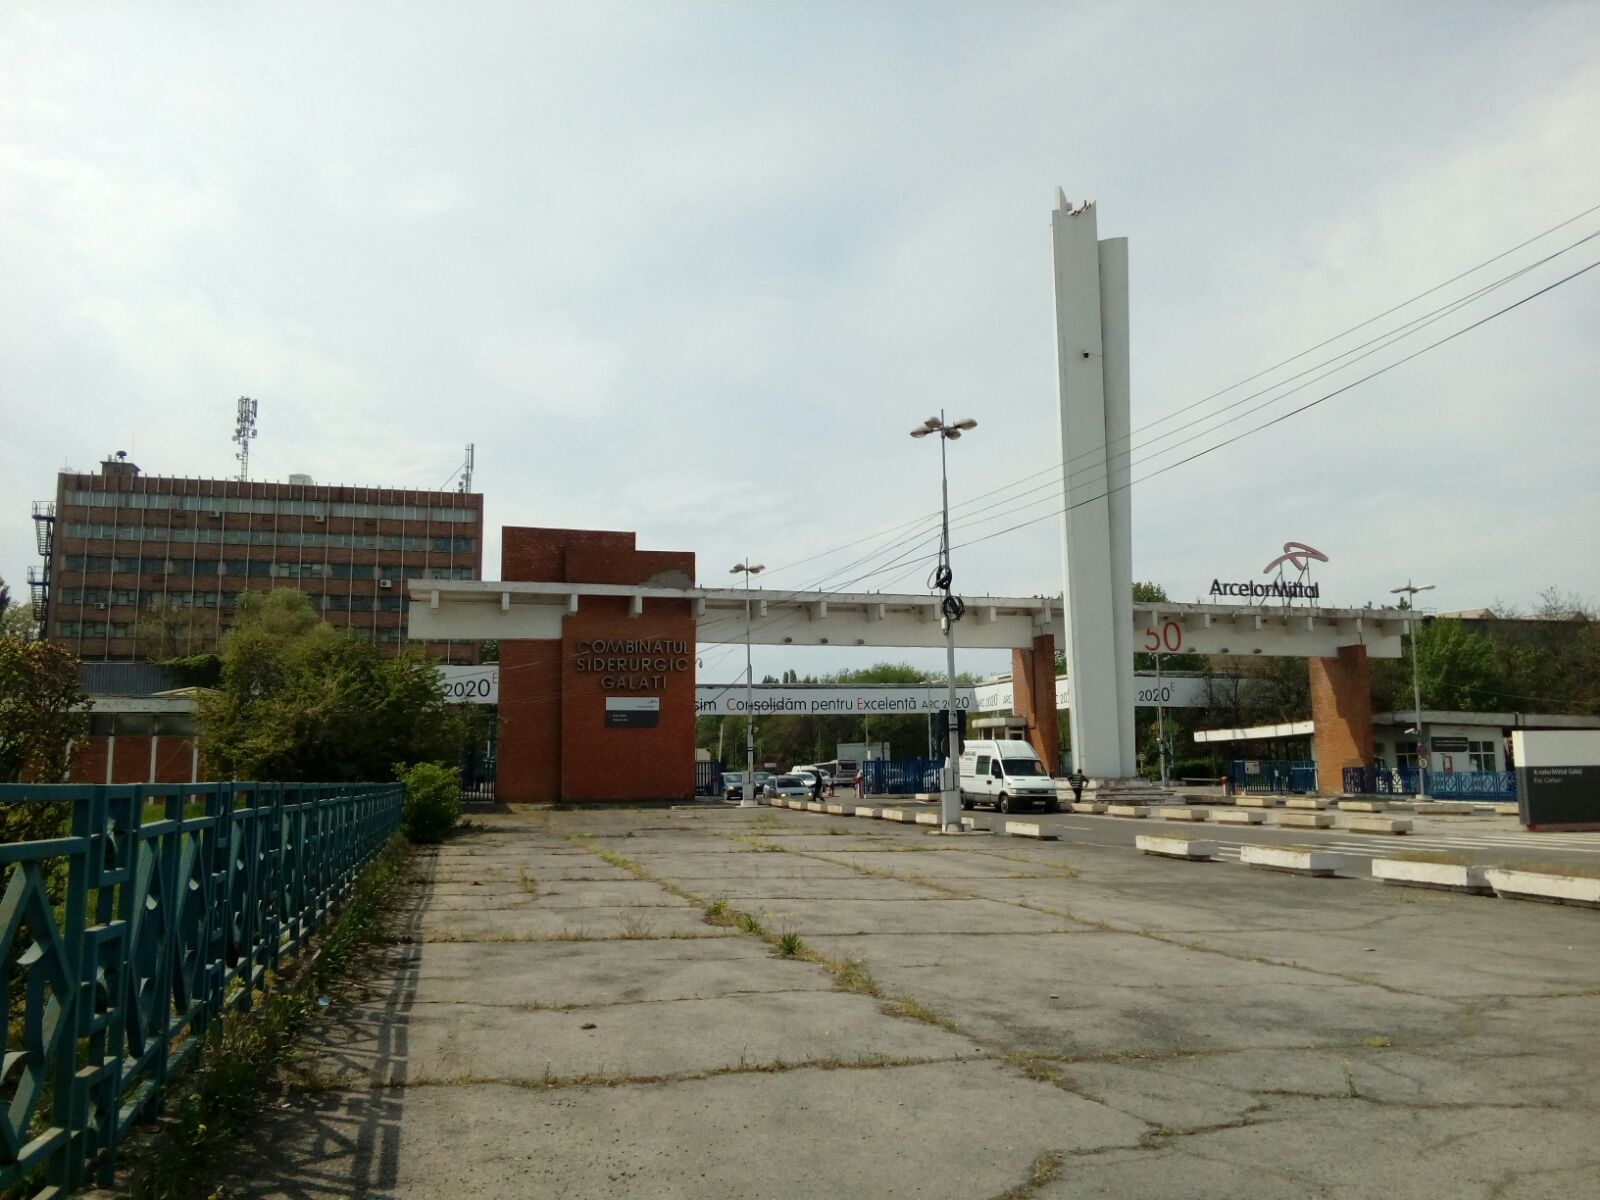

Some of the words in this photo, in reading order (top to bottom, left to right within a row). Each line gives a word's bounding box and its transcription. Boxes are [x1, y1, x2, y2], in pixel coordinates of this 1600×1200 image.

[1209, 578, 1319, 598] ArcelorMittal
[1144, 621, 1182, 652] 50
[576, 639, 691, 654] COMBINATUL
[576, 657, 689, 672] SIDERURGIC
[601, 675, 667, 689] GALATI
[811, 698, 853, 713] pentru
[921, 700, 940, 710] ARC
